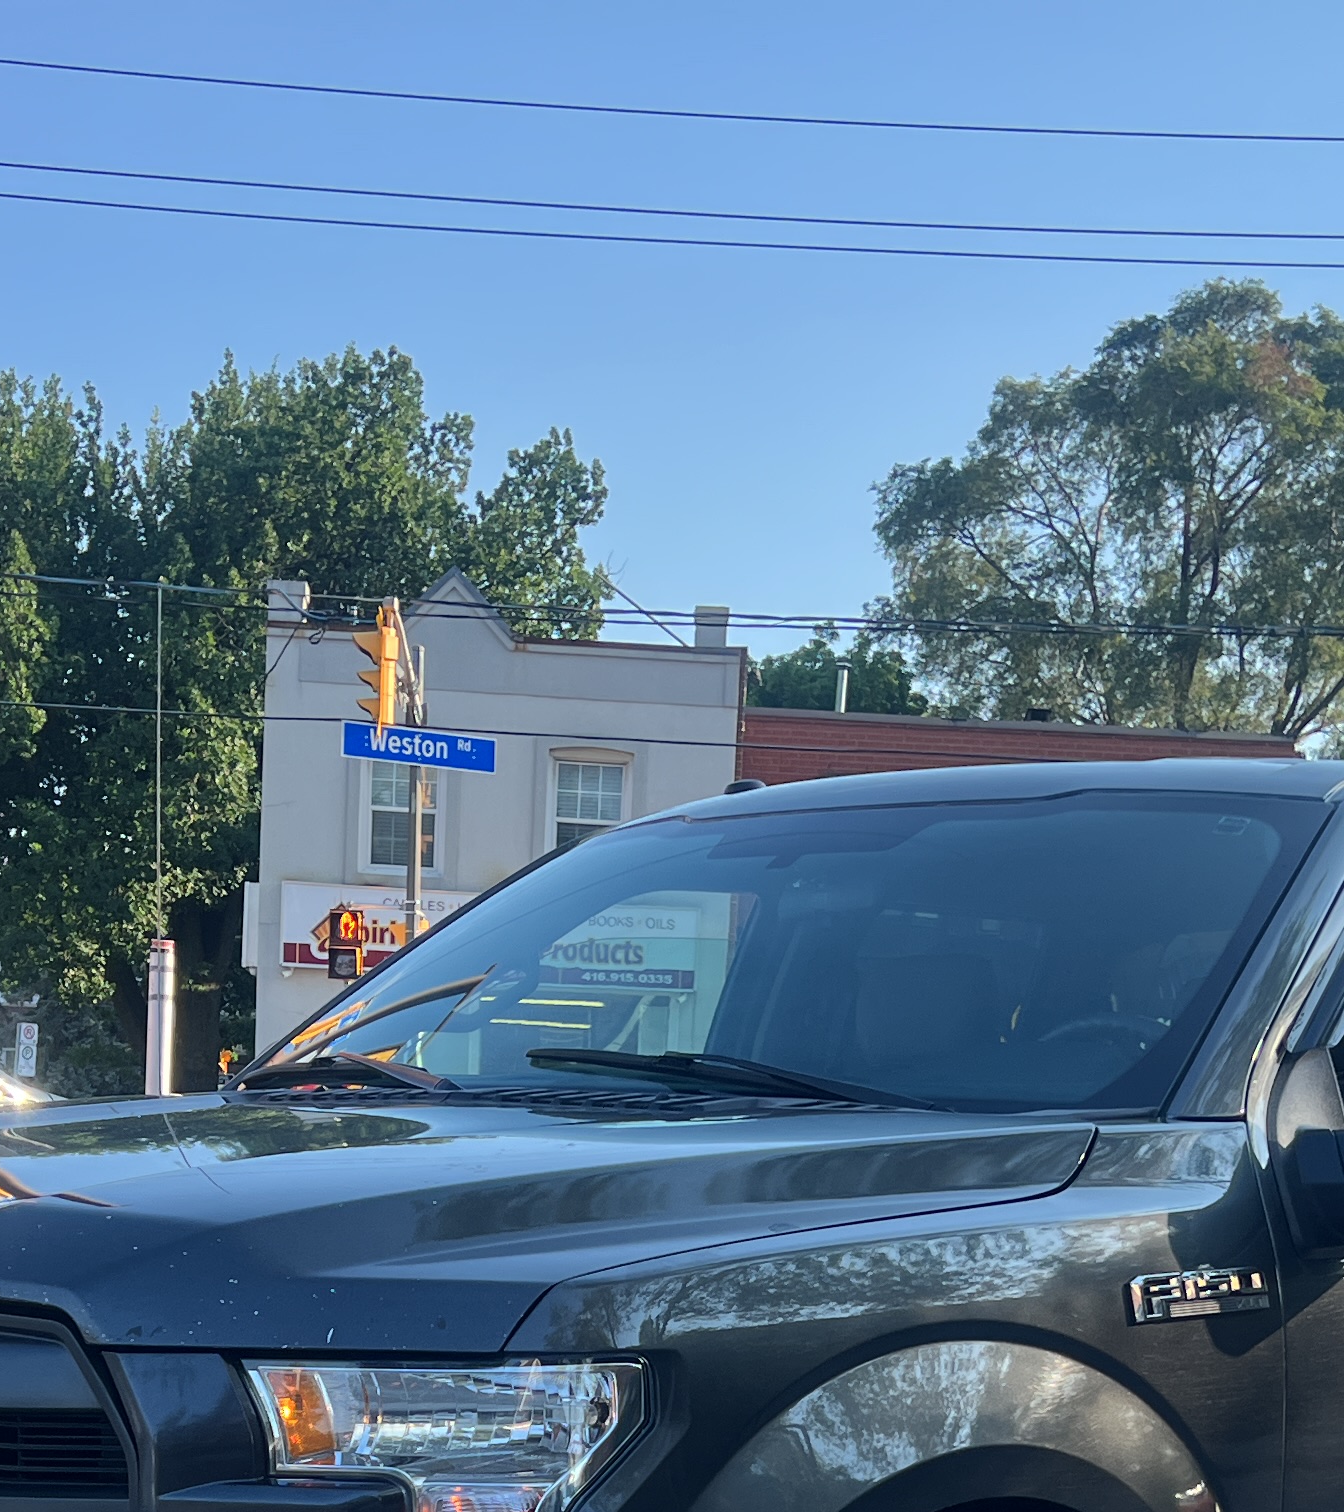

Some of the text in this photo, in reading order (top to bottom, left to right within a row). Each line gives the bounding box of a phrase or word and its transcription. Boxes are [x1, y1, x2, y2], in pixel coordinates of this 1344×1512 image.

[369, 727, 449, 760] Weston
[587, 915, 676, 931] BOOKS OILS
[550, 939, 644, 966] roducts
